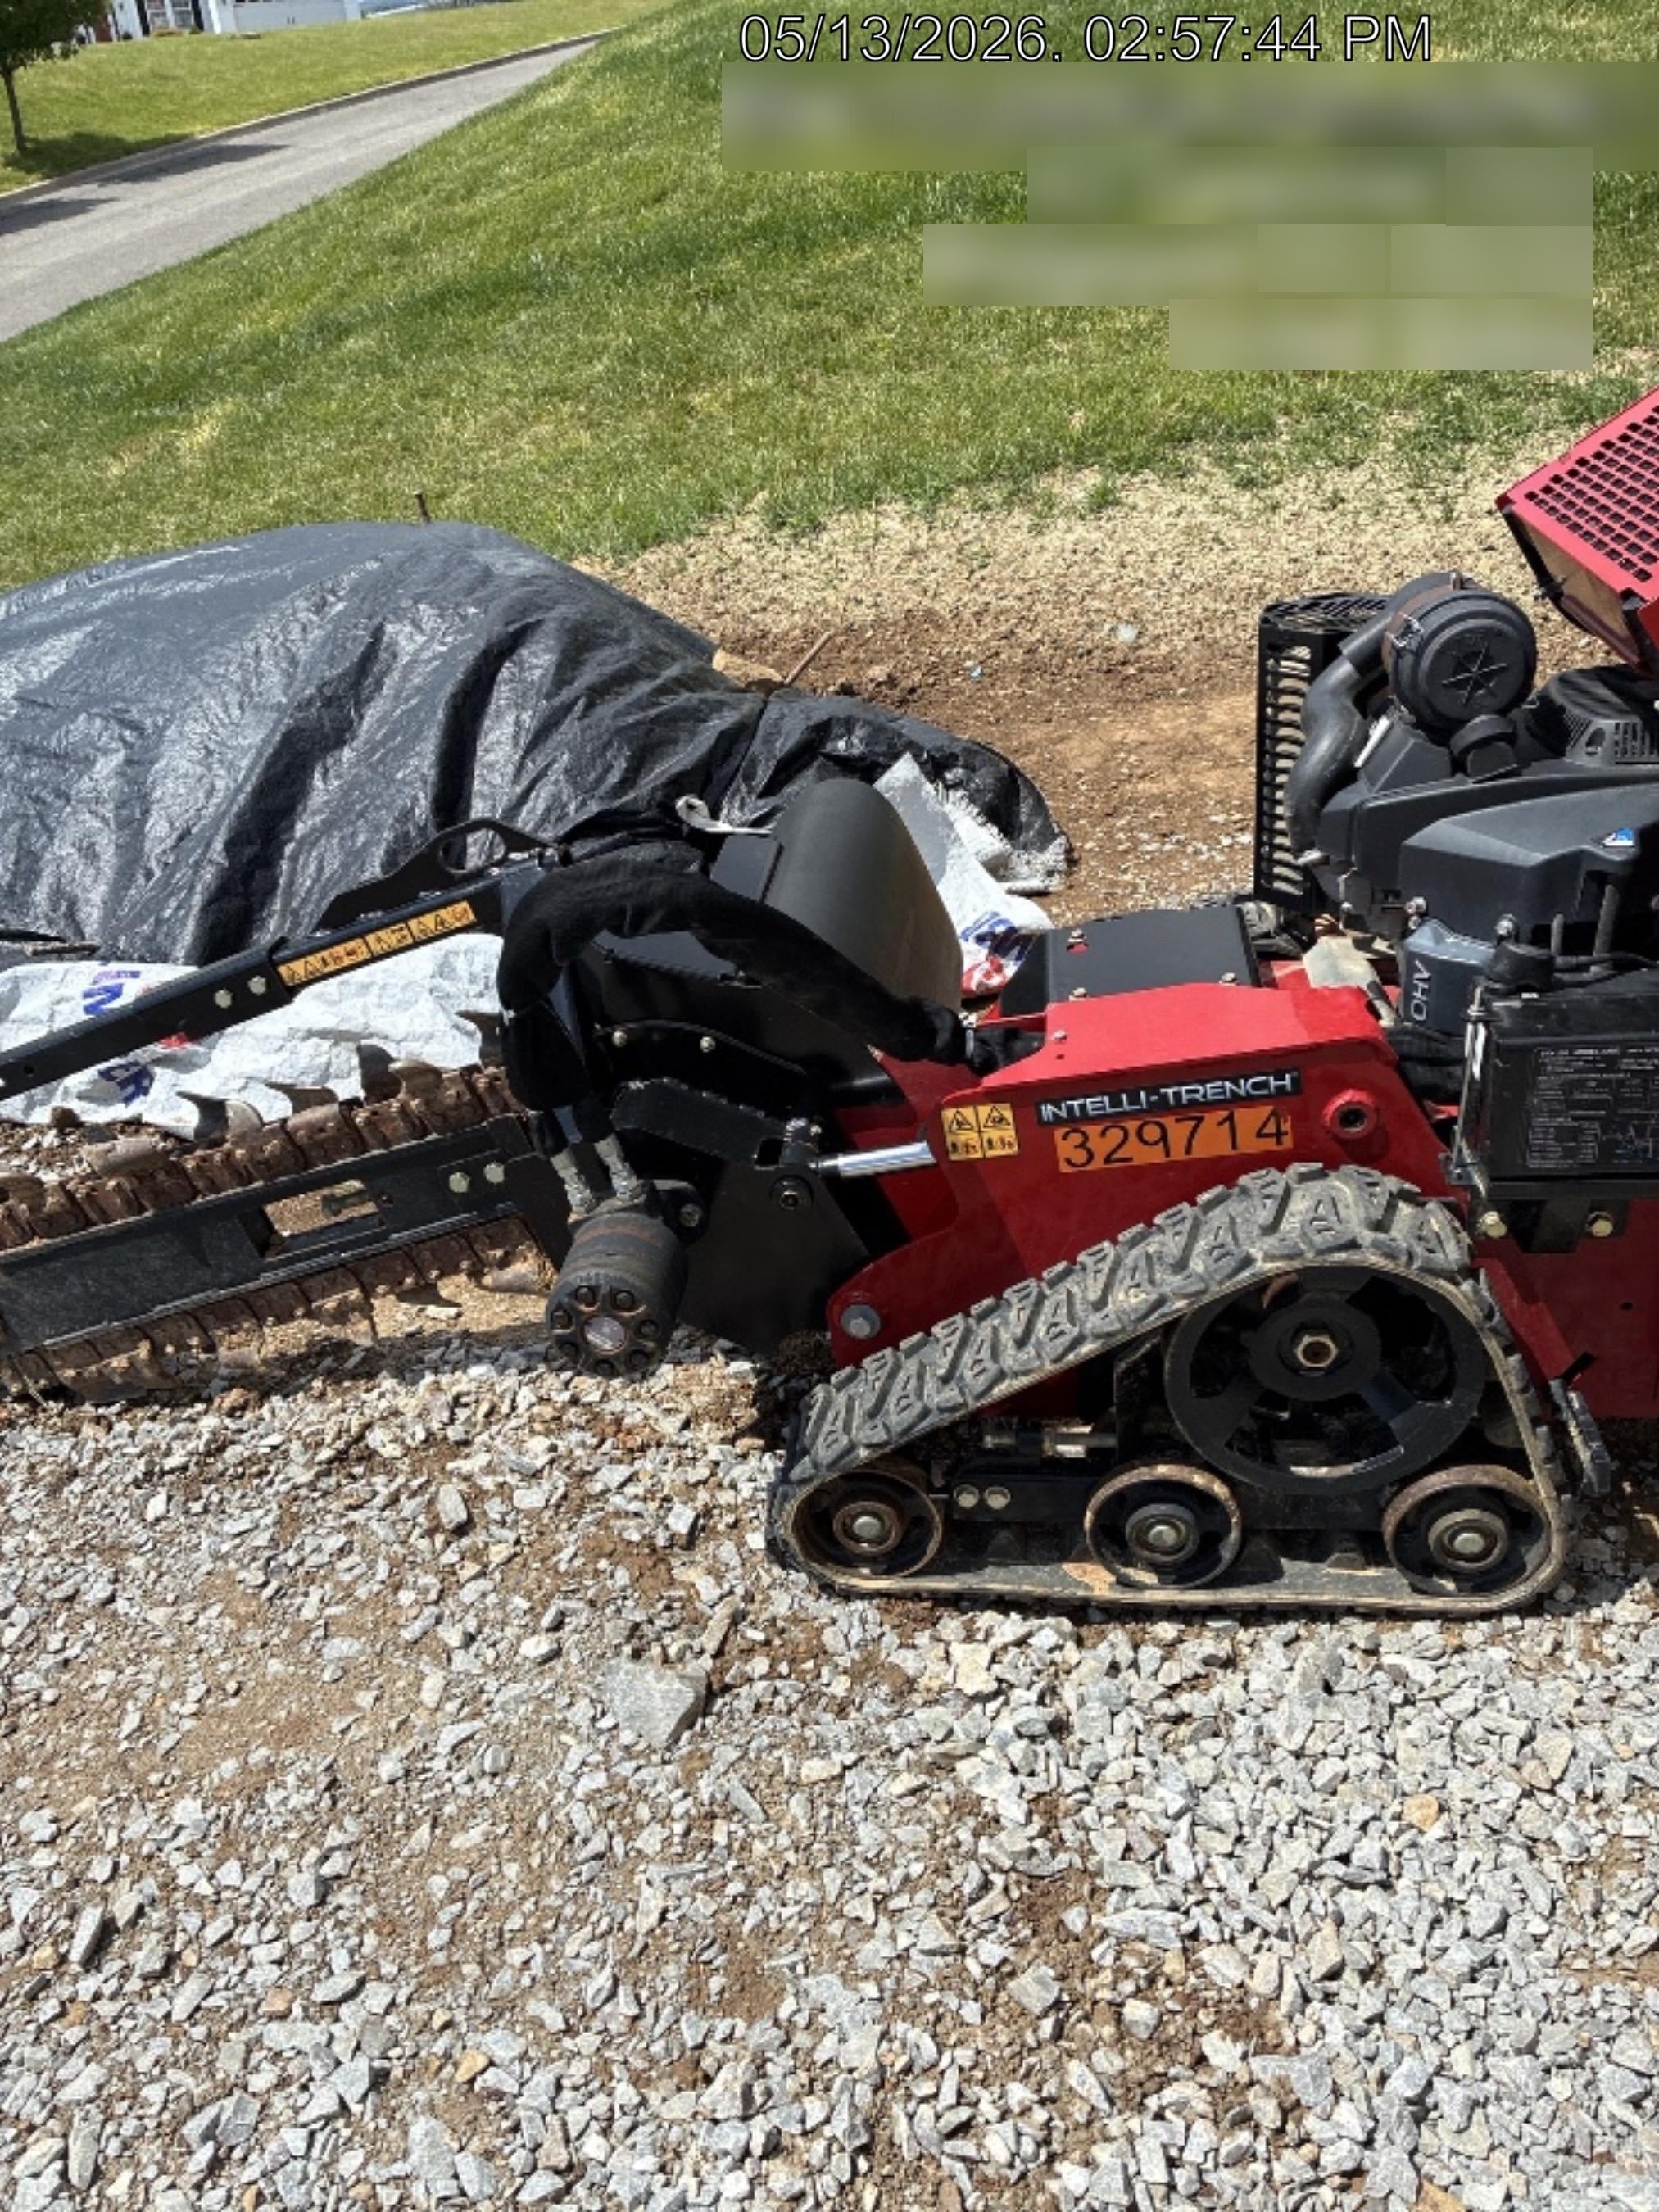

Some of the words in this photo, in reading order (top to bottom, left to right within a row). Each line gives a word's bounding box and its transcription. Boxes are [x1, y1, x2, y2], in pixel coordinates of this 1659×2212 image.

[1411, 960, 1431, 1021] OHV
[1040, 1072, 1292, 1122] INTELLI-TRENCH
[1061, 1108, 1289, 1169] 329714
